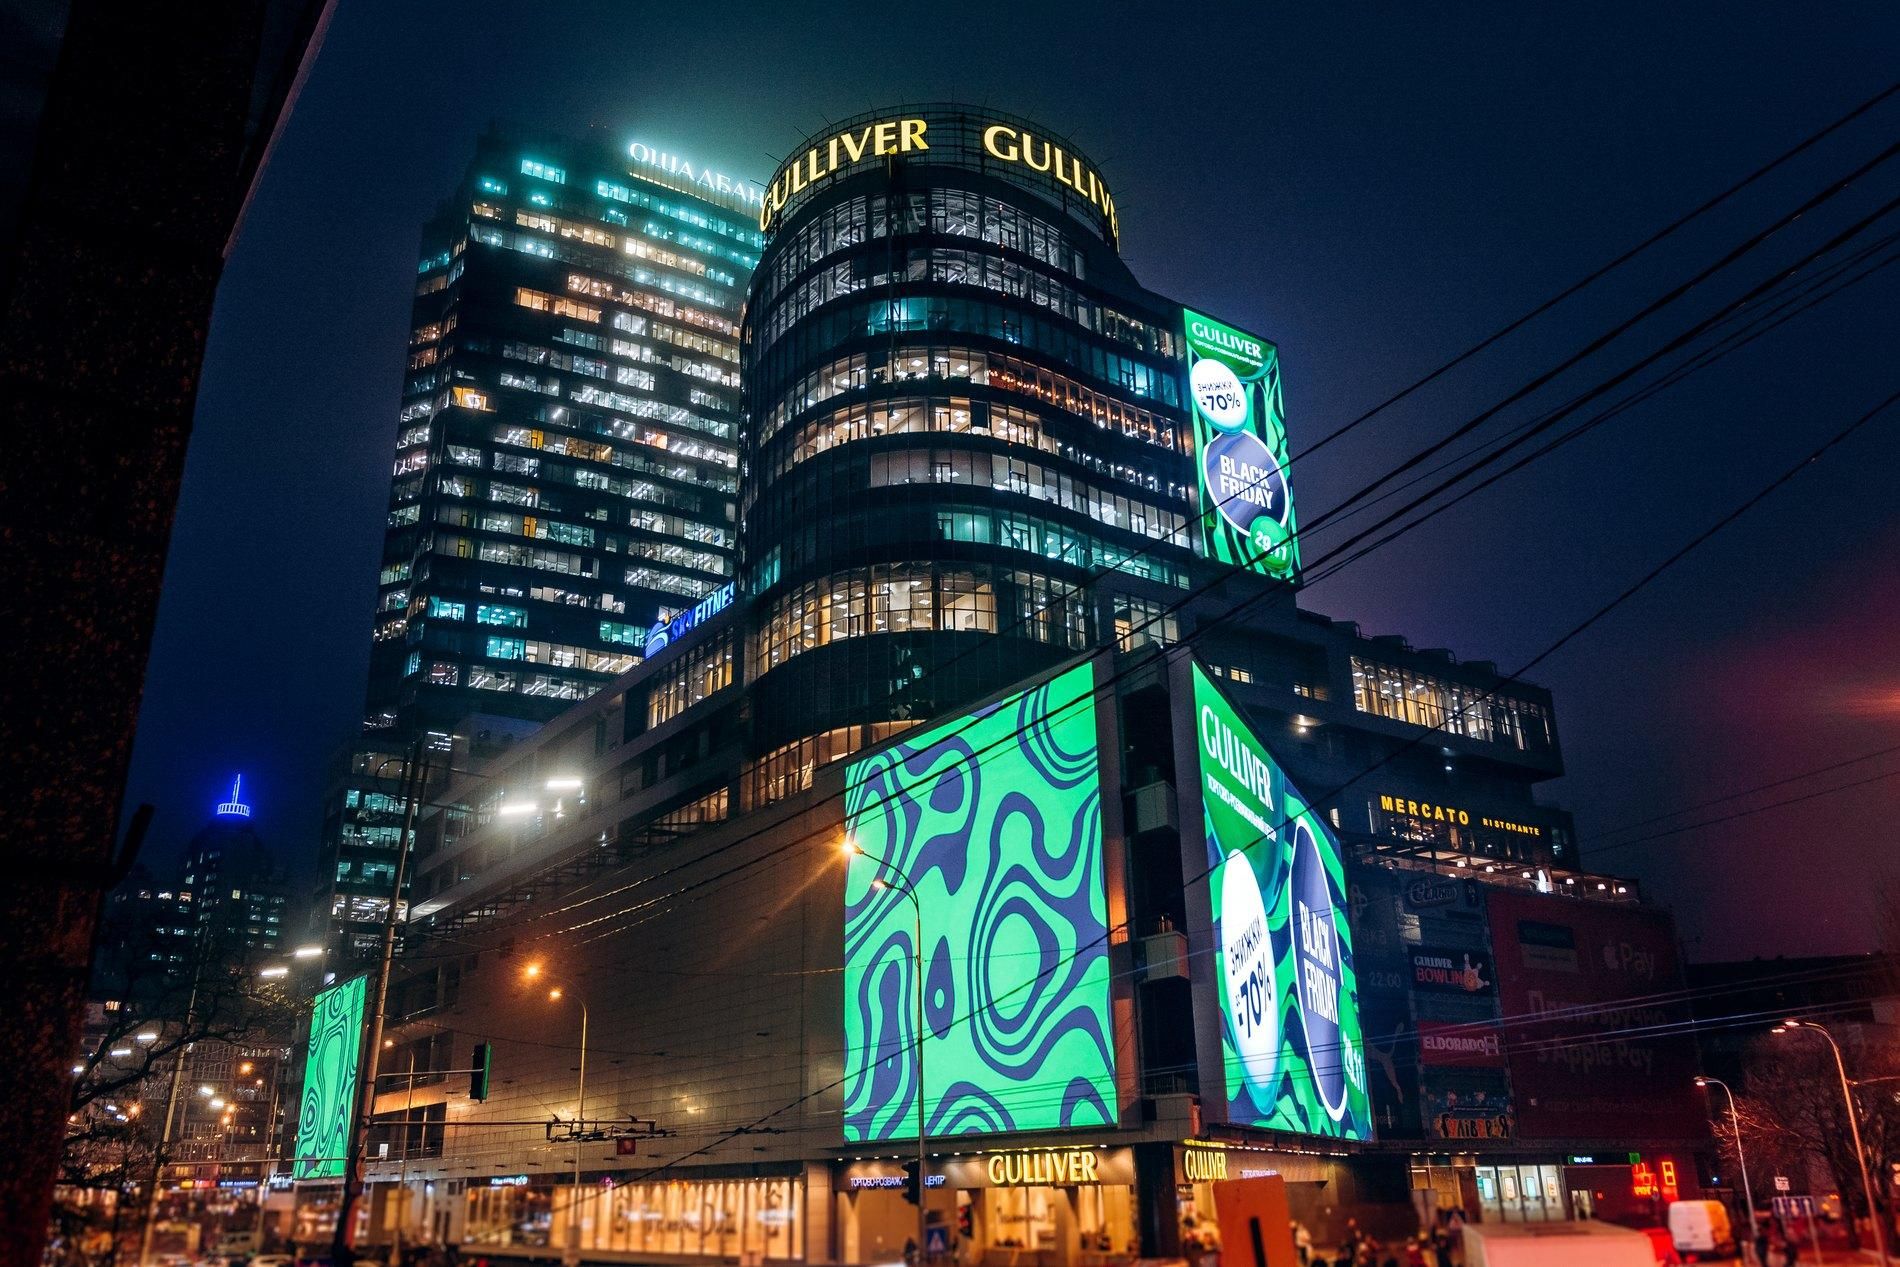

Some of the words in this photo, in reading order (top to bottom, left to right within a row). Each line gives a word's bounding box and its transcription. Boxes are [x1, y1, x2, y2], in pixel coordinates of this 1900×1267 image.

[629, 142, 764, 208] ОЩАДБАН
[760, 119, 930, 232] GULLIVER
[1191, 321, 1263, 359] GULLIVER
[1202, 392, 1241, 411] -70%
[1219, 454, 1270, 489] BLACK
[1219, 474, 1274, 510] FRIDAY
[1202, 704, 1274, 811] GULLIVER
[1380, 795, 1470, 826] MERCATO
[1482, 817, 1540, 836] RISTORANTE
[1231, 915, 1263, 976] ЗНИЖКИ
[1299, 900, 1333, 971] BLACK
[1413, 955, 1453, 969] GULLIVER
[1238, 952, 1271, 1038] -70%
[1303, 957, 1338, 1025] FRIDAY
[1422, 1035, 1486, 1052] ELDORADO
[850, 1176, 905, 1187] ТОРГОВО-РОЗВАЖ
[924, 1175, 946, 1188] ЦЕНТР
[988, 1151, 1099, 1184] GULLIVER
[1185, 1150, 1227, 1180] GULLIVER
